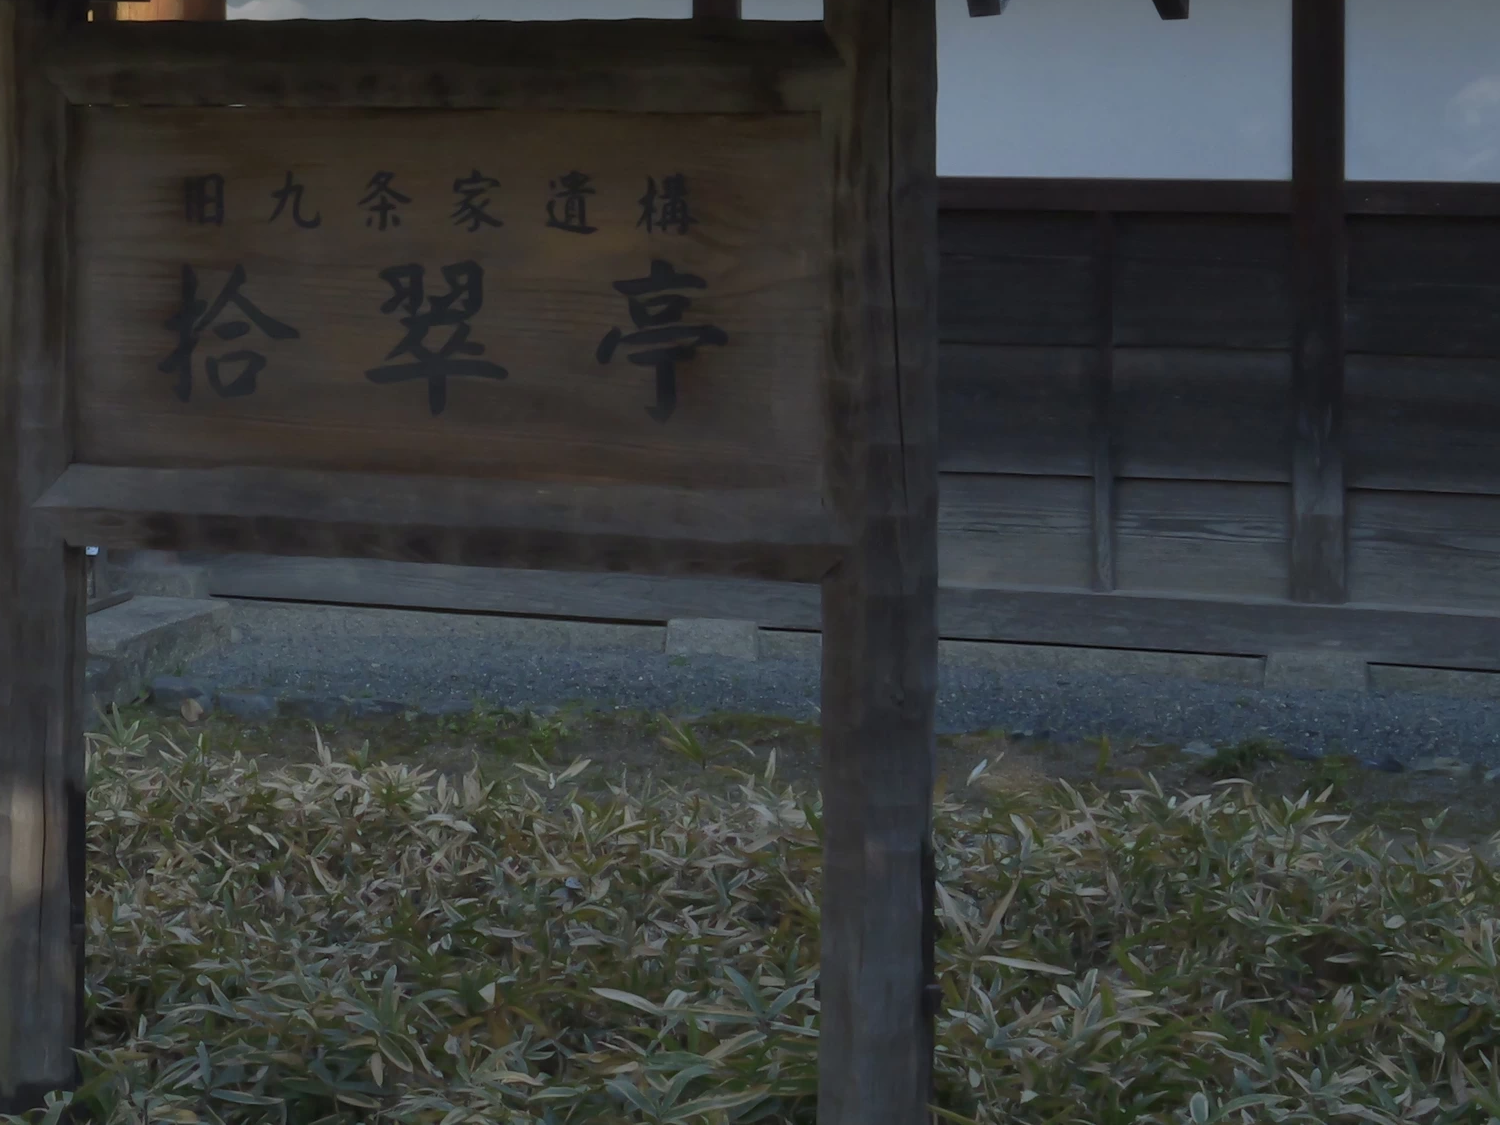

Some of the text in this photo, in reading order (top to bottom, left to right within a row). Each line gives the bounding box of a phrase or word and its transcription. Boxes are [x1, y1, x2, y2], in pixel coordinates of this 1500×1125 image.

[184, 169, 698, 235] 旧九条家遺構
[158, 258, 730, 425] 拾翠亭
